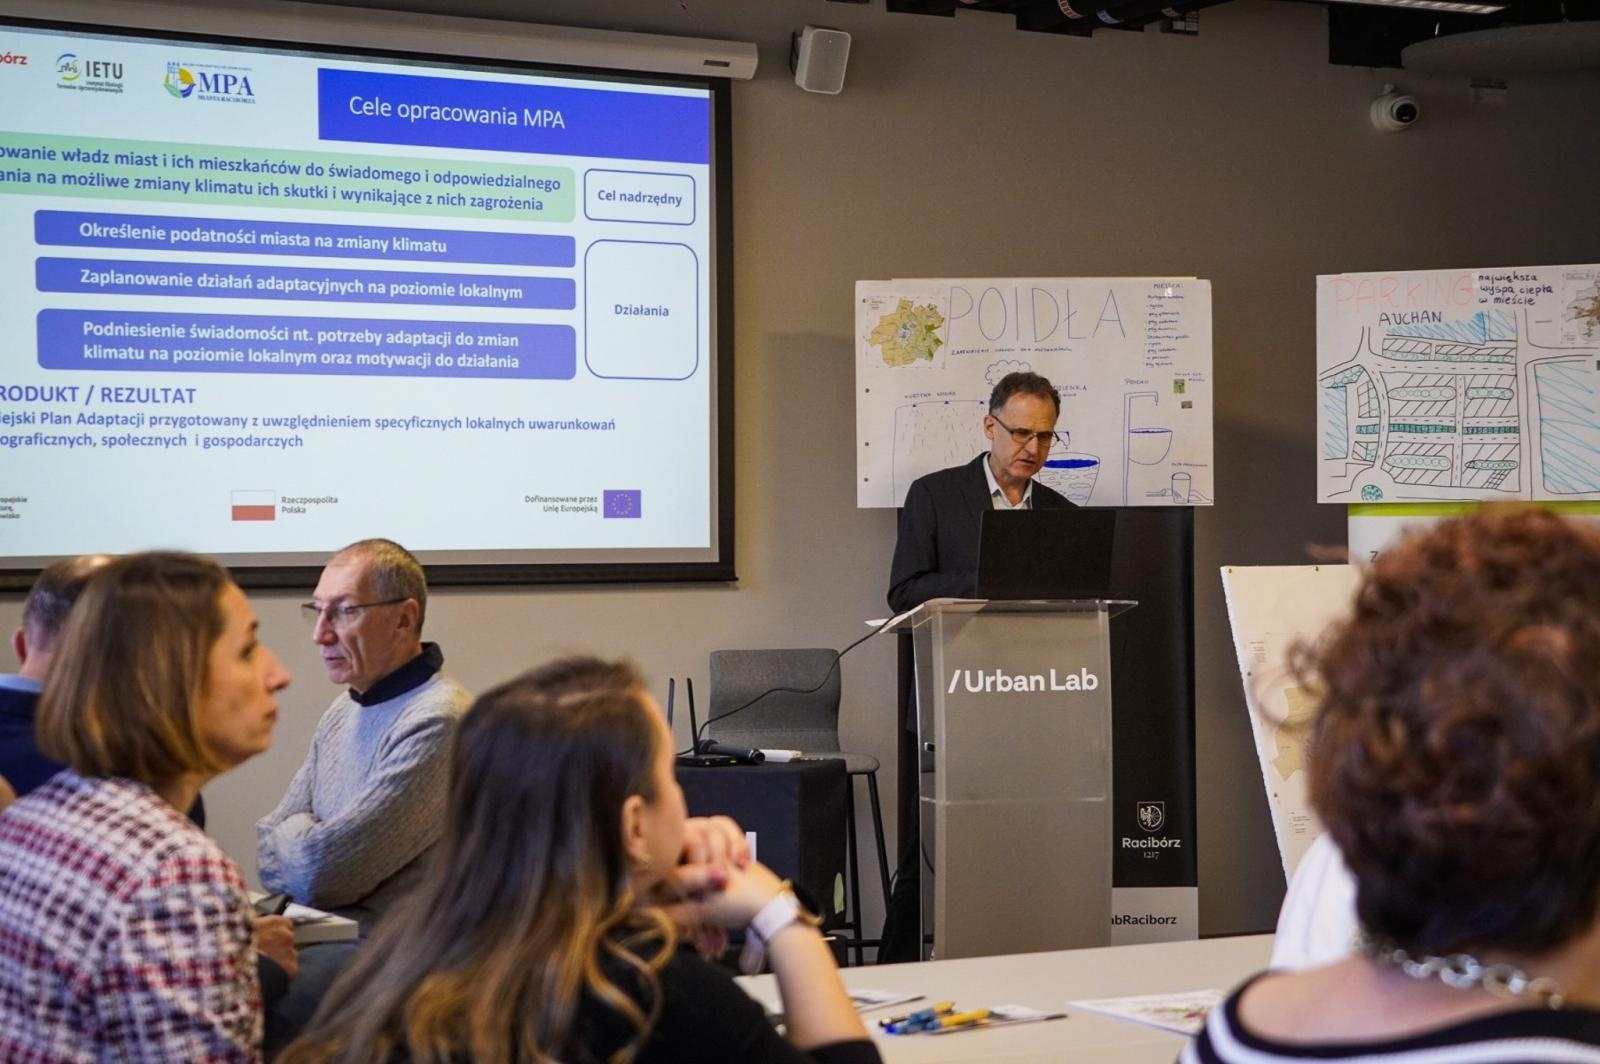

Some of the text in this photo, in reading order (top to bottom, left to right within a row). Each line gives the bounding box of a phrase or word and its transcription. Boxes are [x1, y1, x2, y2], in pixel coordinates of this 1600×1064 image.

[86, 61, 122, 79] IETU
[198, 72, 254, 96] MPA
[349, 96, 565, 129] Cele opracowania MPA
[62, 148, 109, 163] władz
[115, 153, 157, 166] miast
[163, 154, 166, 166] i
[172, 154, 193, 168] ich
[200, 158, 300, 175] mieszkańców
[305, 162, 324, 176] do
[329, 164, 421, 183] świadomego
[425, 170, 429, 182] i
[434, 170, 561, 191] odpowiedzialnego
[37, 172, 56, 183] na
[62, 173, 129, 188] możliwe
[135, 177, 189, 193] zmiany
[195, 179, 252, 195] klimatu
[258, 182, 278, 196] ich
[284, 184, 328, 199] skutki
[333, 187, 336, 200] i
[341, 189, 421, 206] wynikające
[426, 195, 432, 205] z
[437, 193, 466, 206] nich
[471, 194, 543, 211] zagrożenia
[598, 190, 682, 207] Cel nadrzędny
[80, 223, 447, 254] Określenie podatności miasta na zmiany klimatu
[80, 269, 522, 300] Zaplanowanie działań adaptacyjnych na poziomie lokalnym
[1479, 272, 1538, 285] największa
[1329, 274, 1474, 315] PARKING
[1520, 284, 1554, 296] ciepła
[1494, 294, 1535, 305] mieście
[615, 304, 669, 317] Działania
[947, 286, 1127, 344] POIDŁA
[1379, 311, 1443, 326] AUCHAN
[83, 322, 518, 347] Podniesienie świadomości nt. potrzeby adaptacji do zmian
[84, 345, 519, 368] klimatu na poziomie lokalnym oraz motywacji do działania
[101, 387, 196, 403] REZULTAT
[41, 412, 71, 425] Plan
[77, 412, 144, 428] Adaptacji
[150, 414, 248, 429] przygotowany
[252, 418, 258, 427] z
[263, 415, 371, 429] uwzględnieniem
[375, 416, 461, 431] specyficznych
[466, 417, 524, 431] lokalnych
[529, 418, 615, 431] uwarunkowań
[0, 433, 302, 450] ograficznych, społecznych i gospodarczych
[282, 496, 338, 505] Rzeczpospolita
[282, 506, 306, 514] Polska
[1050, 668, 1098, 691] Lab
[1122, 837, 1181, 848] Racibórz
